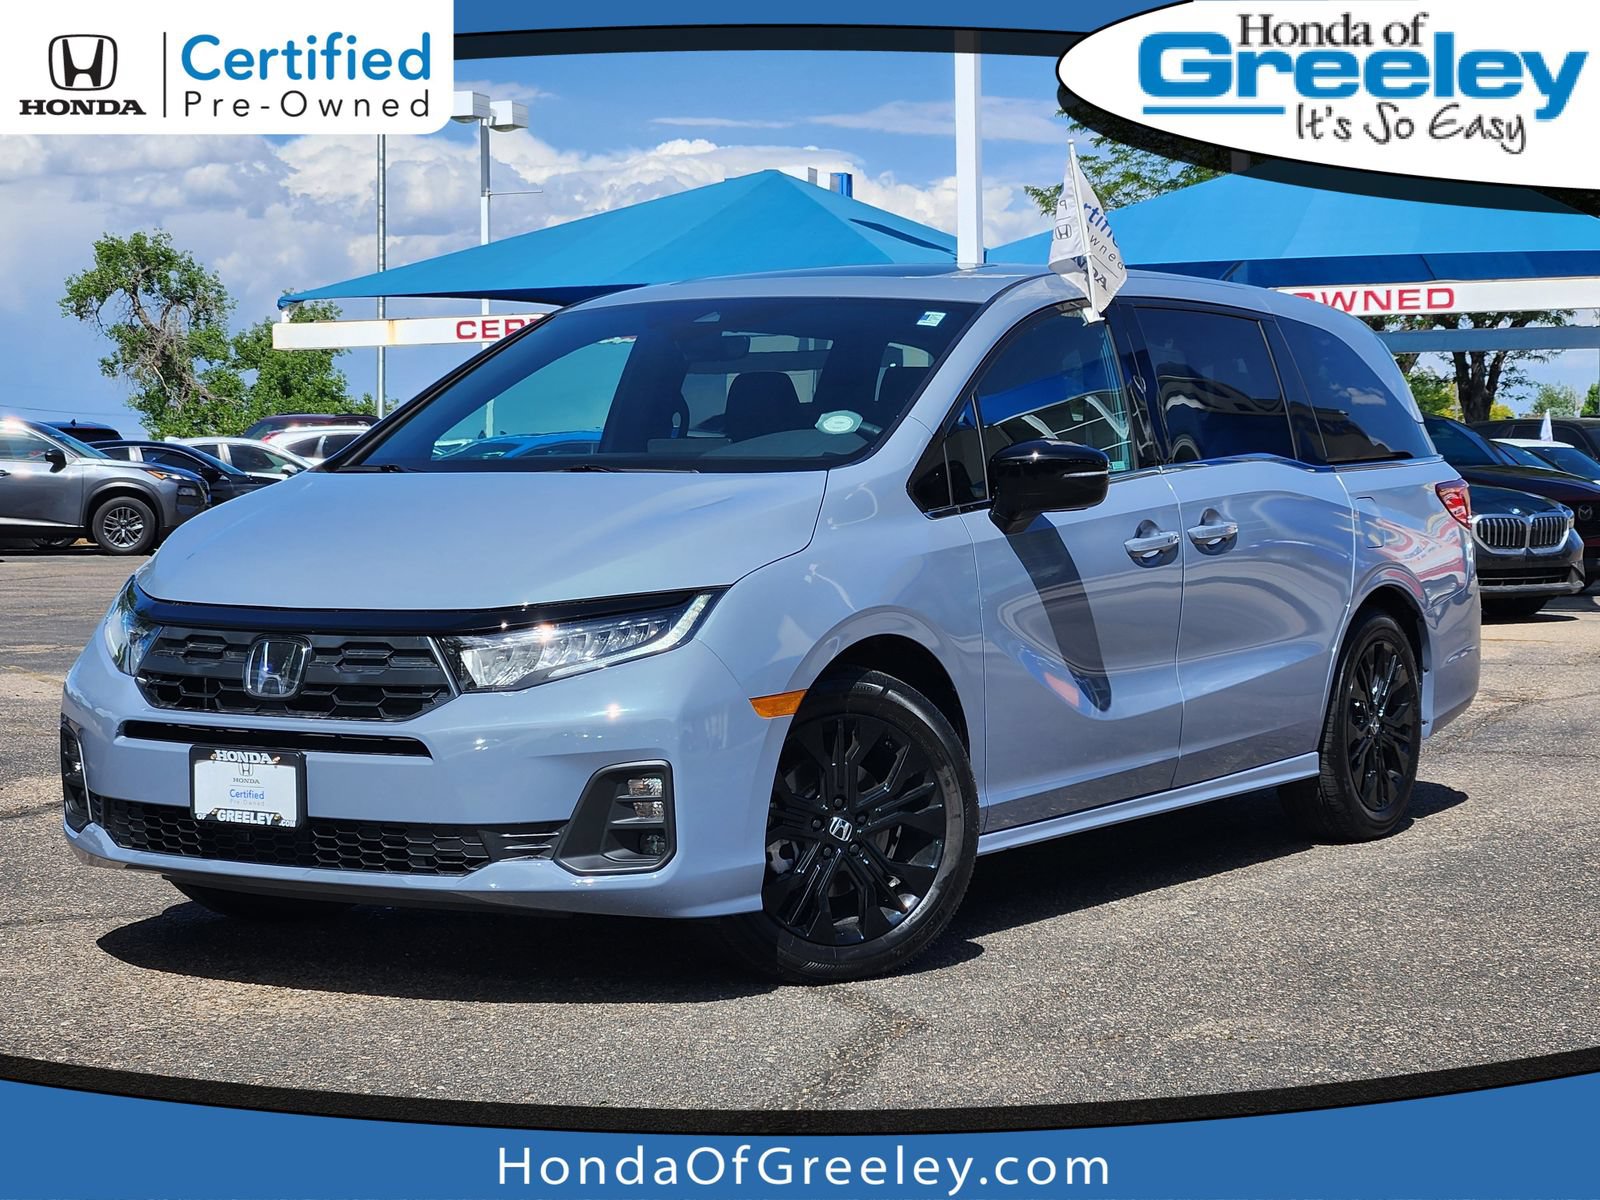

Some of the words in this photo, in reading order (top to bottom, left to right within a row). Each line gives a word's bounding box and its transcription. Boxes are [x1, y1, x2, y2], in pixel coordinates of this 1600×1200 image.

[456, 318, 538, 340] CER
[214, 749, 276, 765] HONDA
[232, 777, 261, 785] HONDA
[229, 789, 265, 800] Certified
[216, 809, 274, 825] GREELEY
